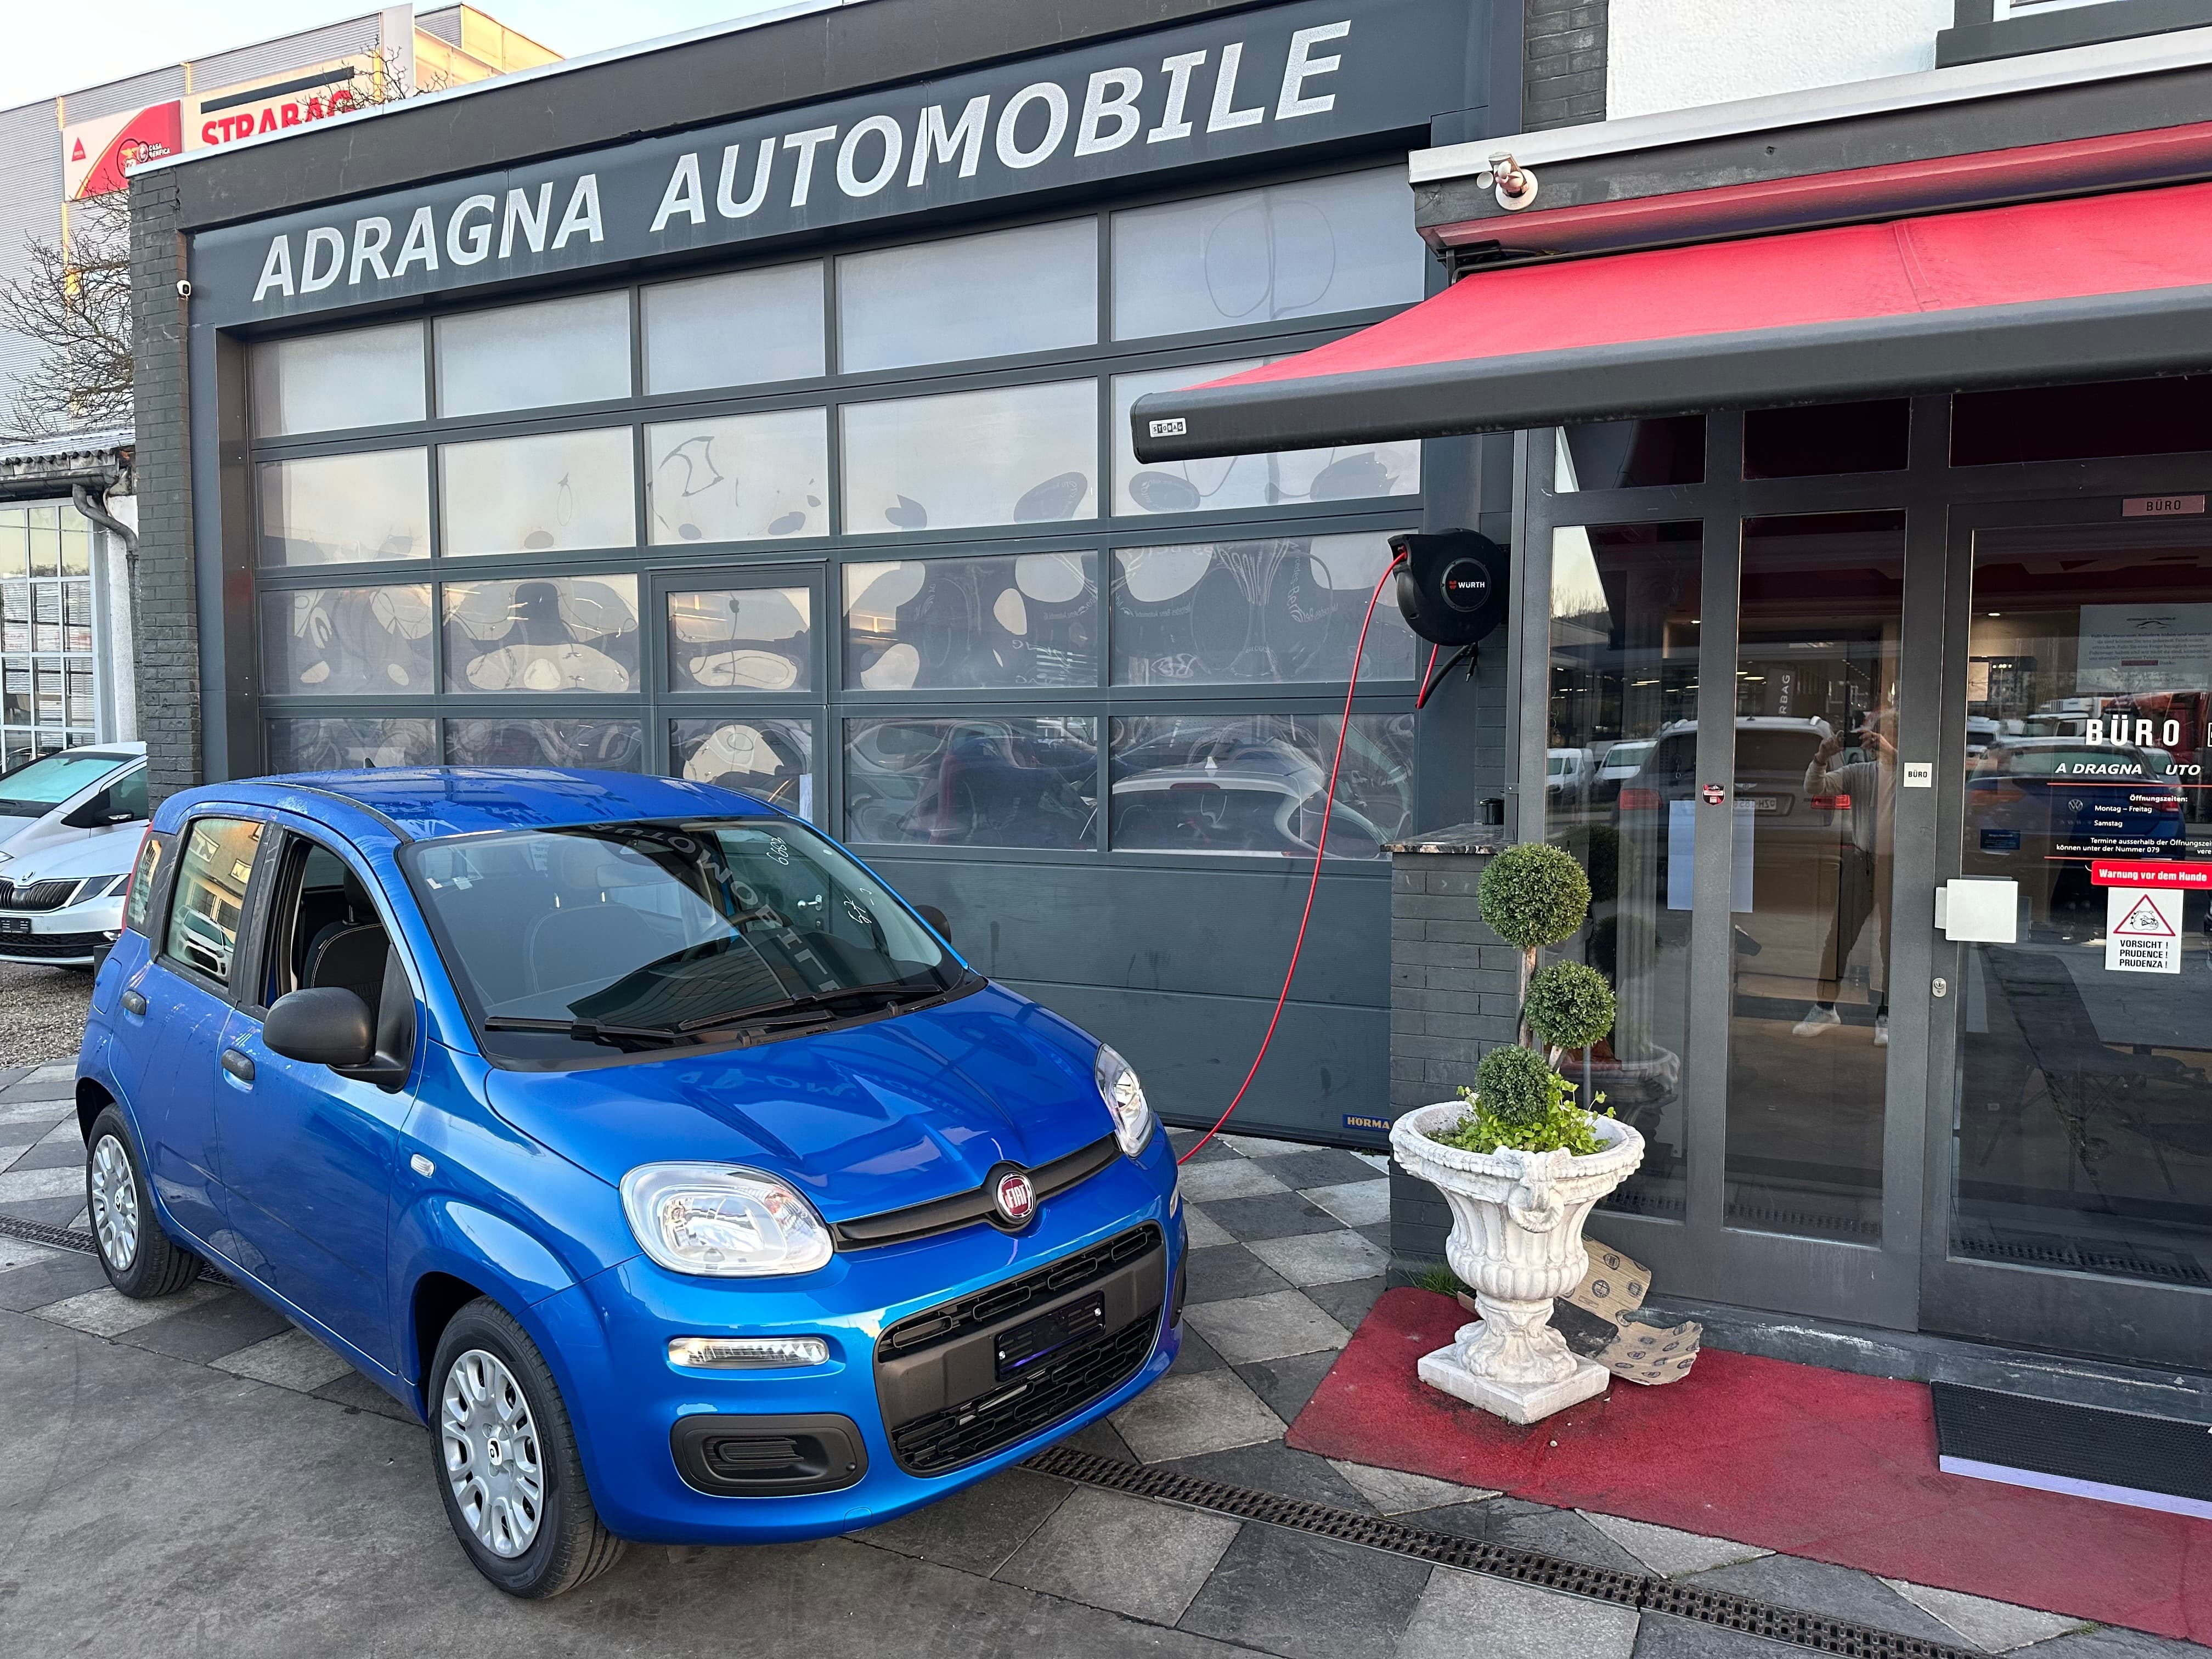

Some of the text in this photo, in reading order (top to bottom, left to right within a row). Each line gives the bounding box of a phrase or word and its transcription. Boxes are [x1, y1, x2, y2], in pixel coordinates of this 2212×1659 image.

[149, 143, 162, 151] CASA
[252, 20, 1350, 302] ADRAGNA AUTOMOBILE
[2146, 499, 2181, 511] BÜRO
[2085, 714, 2180, 746] BÜRO
[1908, 770, 1927, 778] BÜRO
[2165, 764, 2201, 775] UTO
[2130, 794, 2188, 803] Öffnungszeiten:
[2095, 805, 2121, 813] Montag
[2094, 820, 2123, 828] Samstag
[2170, 838, 2212, 848] Öffnungszei
[2099, 868, 2207, 882] Warnung vor dem Hunde
[2120, 940, 2163, 949] VORSICHT
[2120, 950, 2163, 958] PRUDENCE
[2119, 959, 2163, 968] PRUDENZA
[1347, 1116, 1390, 1129] HÖRMA
[1006, 1184, 1027, 1209] FIAT
